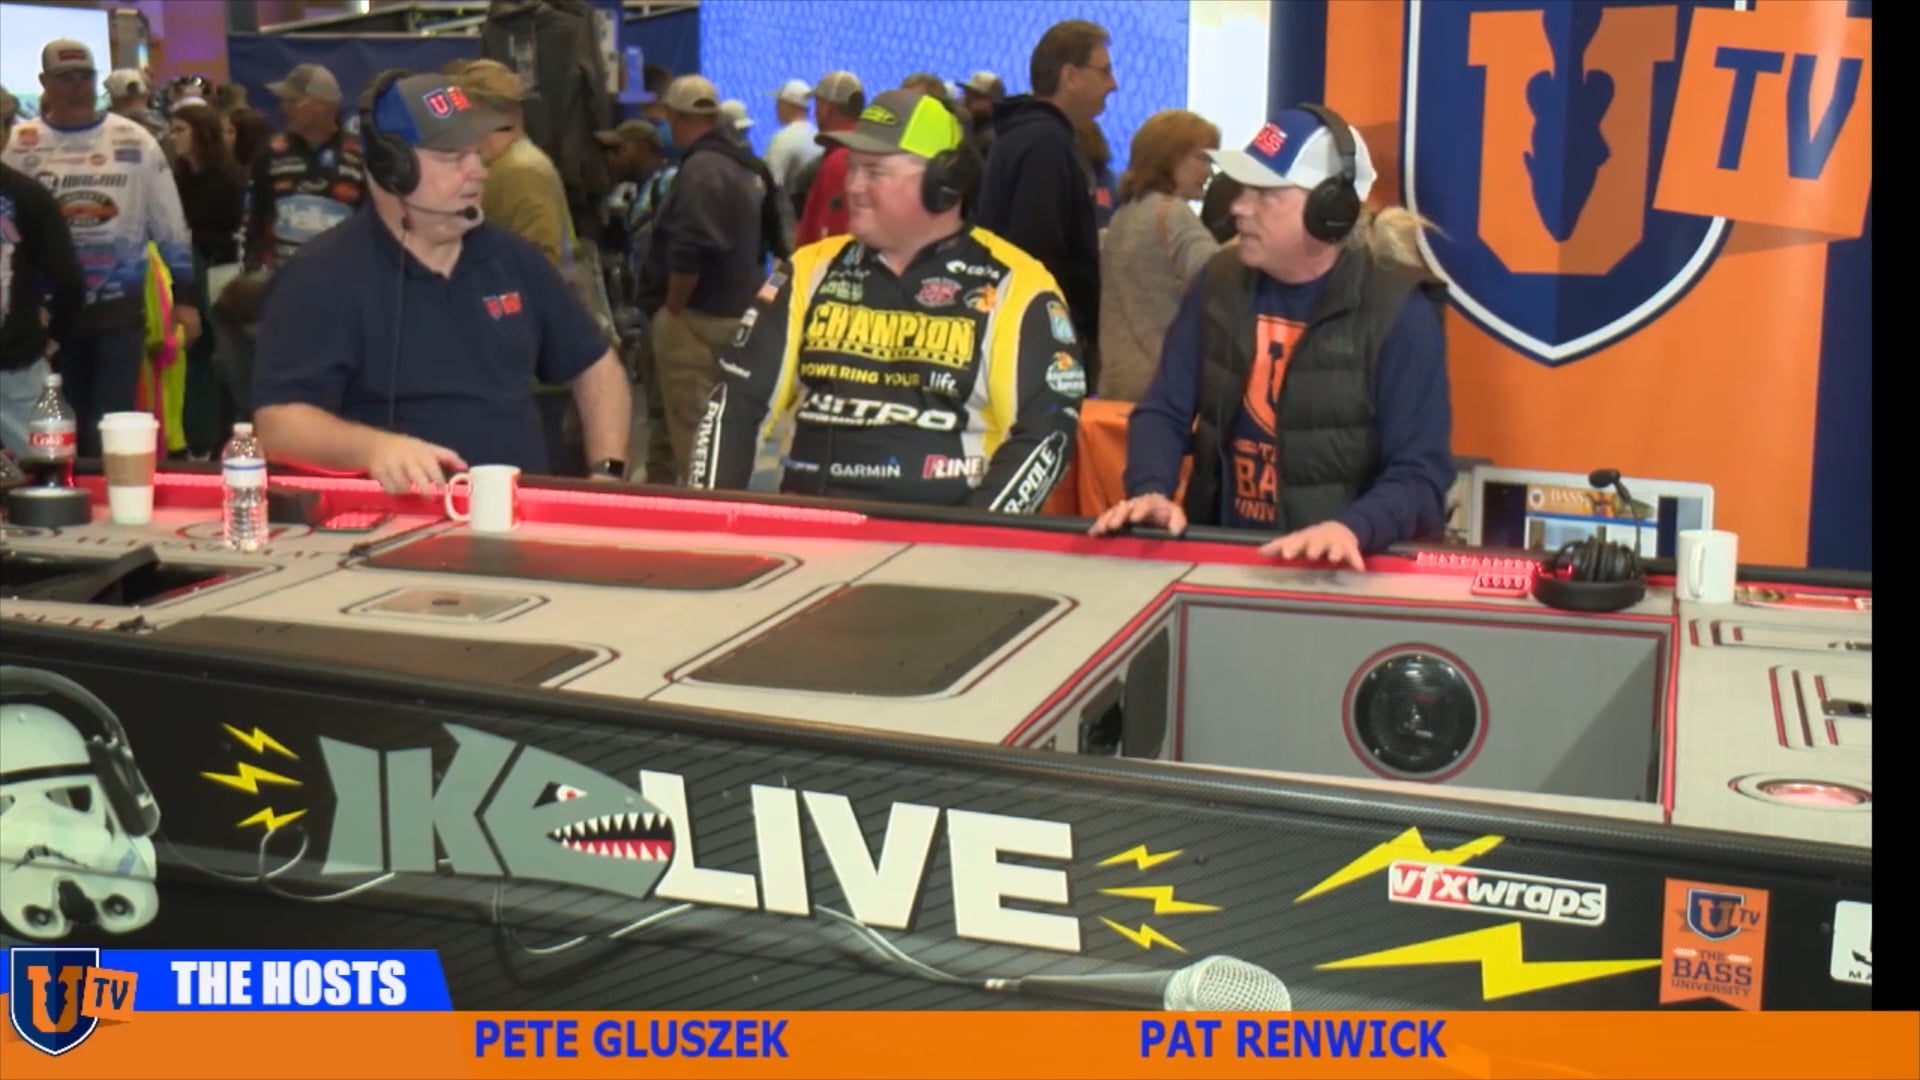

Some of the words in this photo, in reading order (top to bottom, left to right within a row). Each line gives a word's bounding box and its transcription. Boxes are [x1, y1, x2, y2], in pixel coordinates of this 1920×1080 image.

[1713, 46, 1864, 180] TV
[807, 301, 976, 362] CHAMPION
[884, 372, 921, 387] YOUR
[801, 393, 958, 431] NITRO
[830, 462, 902, 478] GARMIN
[1391, 863, 1604, 918] vfxwraps
[1738, 907, 1761, 925] TV
[1699, 951, 1727, 961] THE
[1672, 957, 1753, 987] BASS
[1670, 977, 1751, 997] UNIVERSITY
